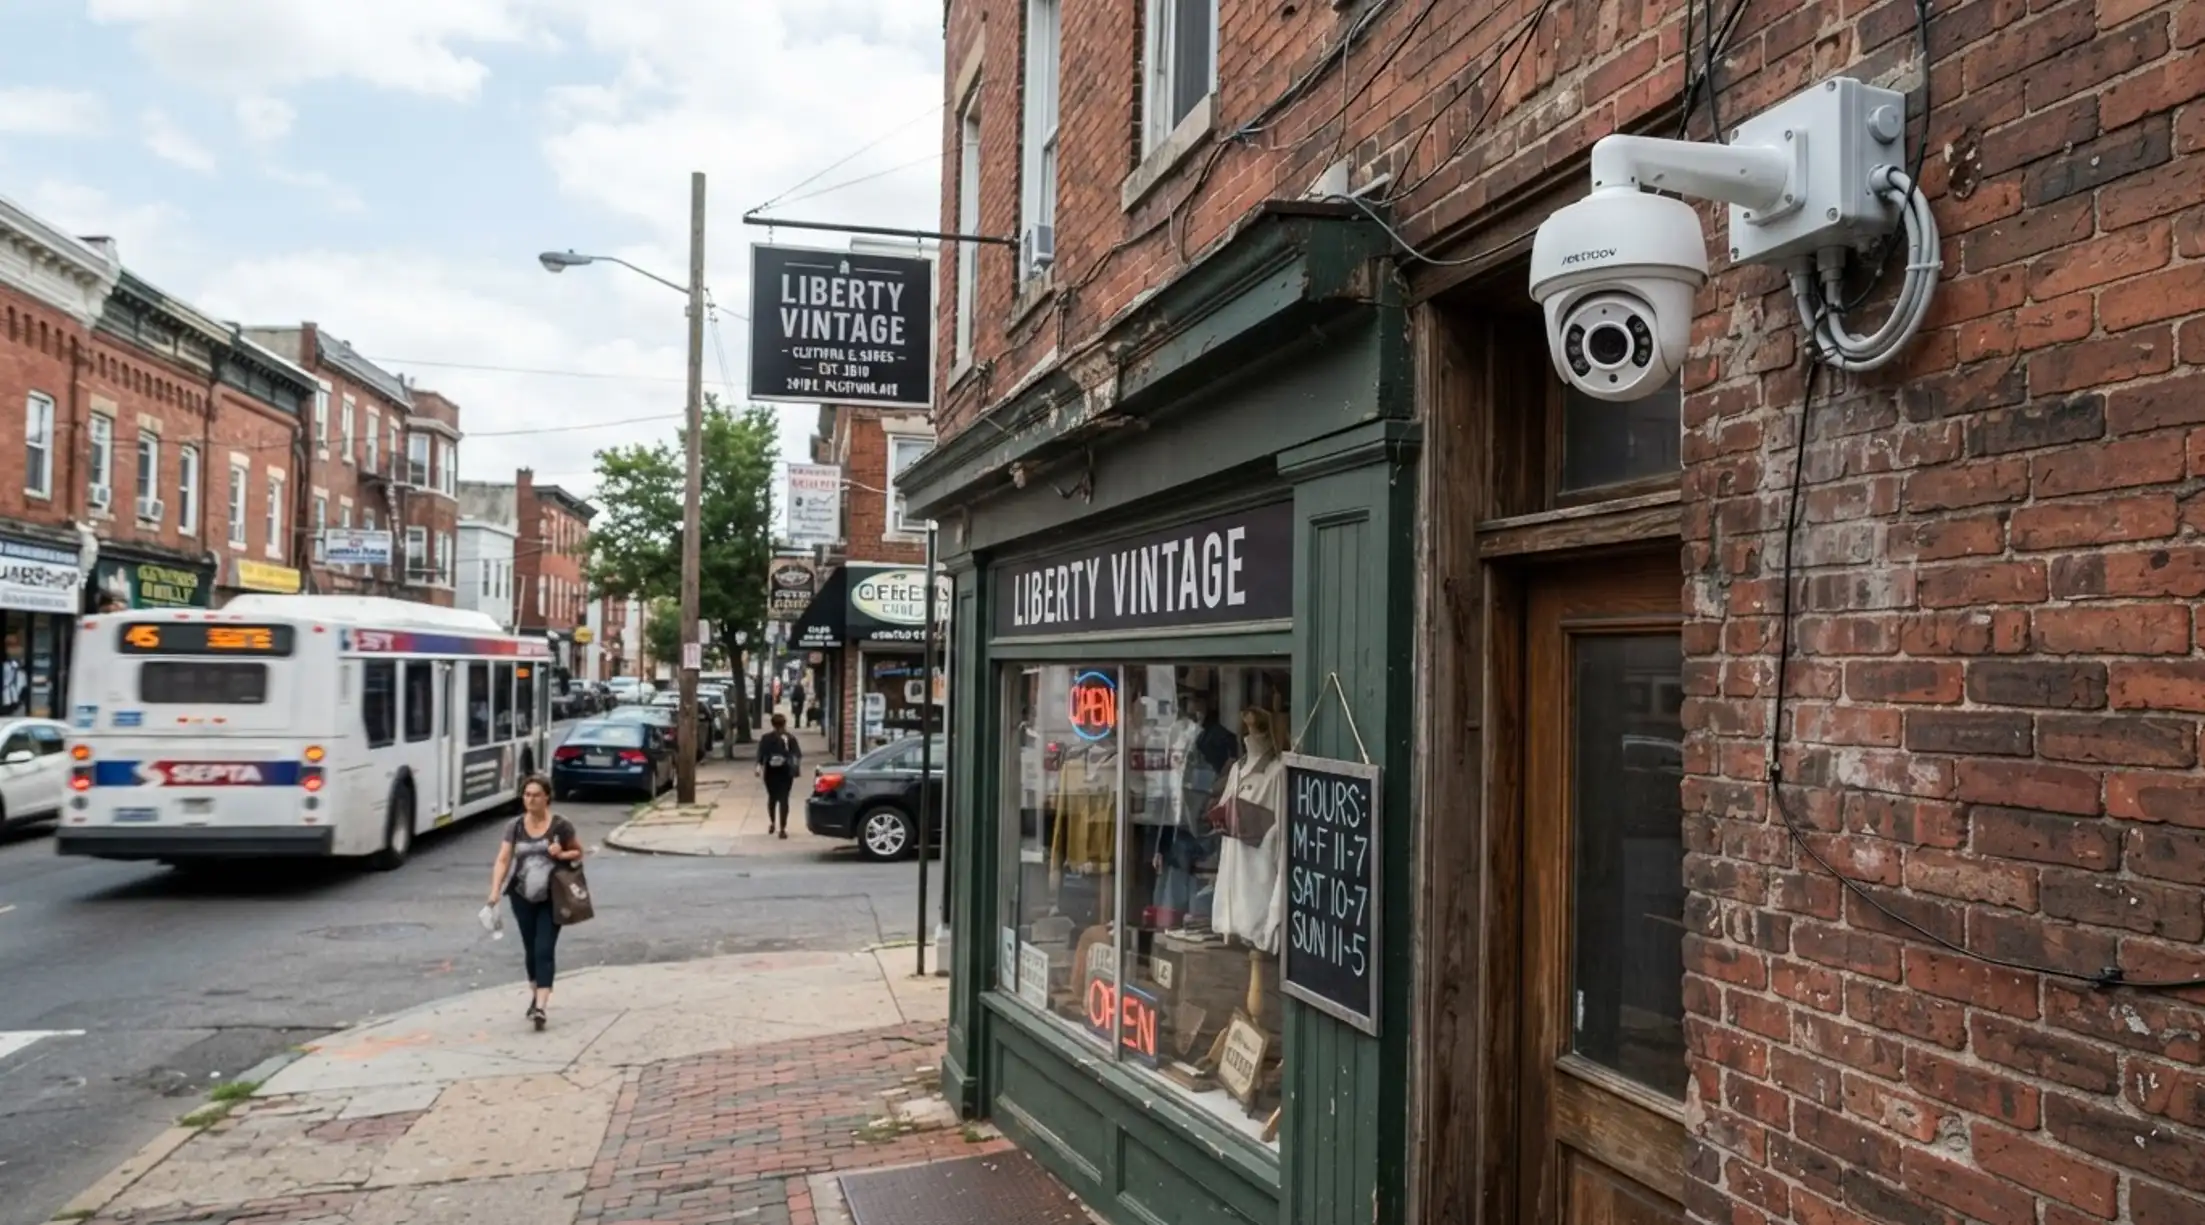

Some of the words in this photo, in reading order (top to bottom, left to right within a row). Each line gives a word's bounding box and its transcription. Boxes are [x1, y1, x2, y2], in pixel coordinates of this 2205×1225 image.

[781, 274, 905, 312] LIBERTY
[780, 307, 905, 345] VINTAGE
[1014, 557, 1100, 626] LIBERTY
[1111, 526, 1246, 616] VINTAGE
[1069, 686, 1115, 727] OPEN
[170, 764, 262, 783] SEPTA
[1297, 775, 1367, 828] HOURS:
[1293, 822, 1329, 864] M-F
[1333, 831, 1368, 877] 11-7
[1291, 866, 1326, 910] SAT
[1330, 879, 1368, 926] 10-7
[1291, 911, 1326, 958] SUN
[1331, 925, 1367, 977] 11-5
[1088, 979, 1156, 1057] OPEN
